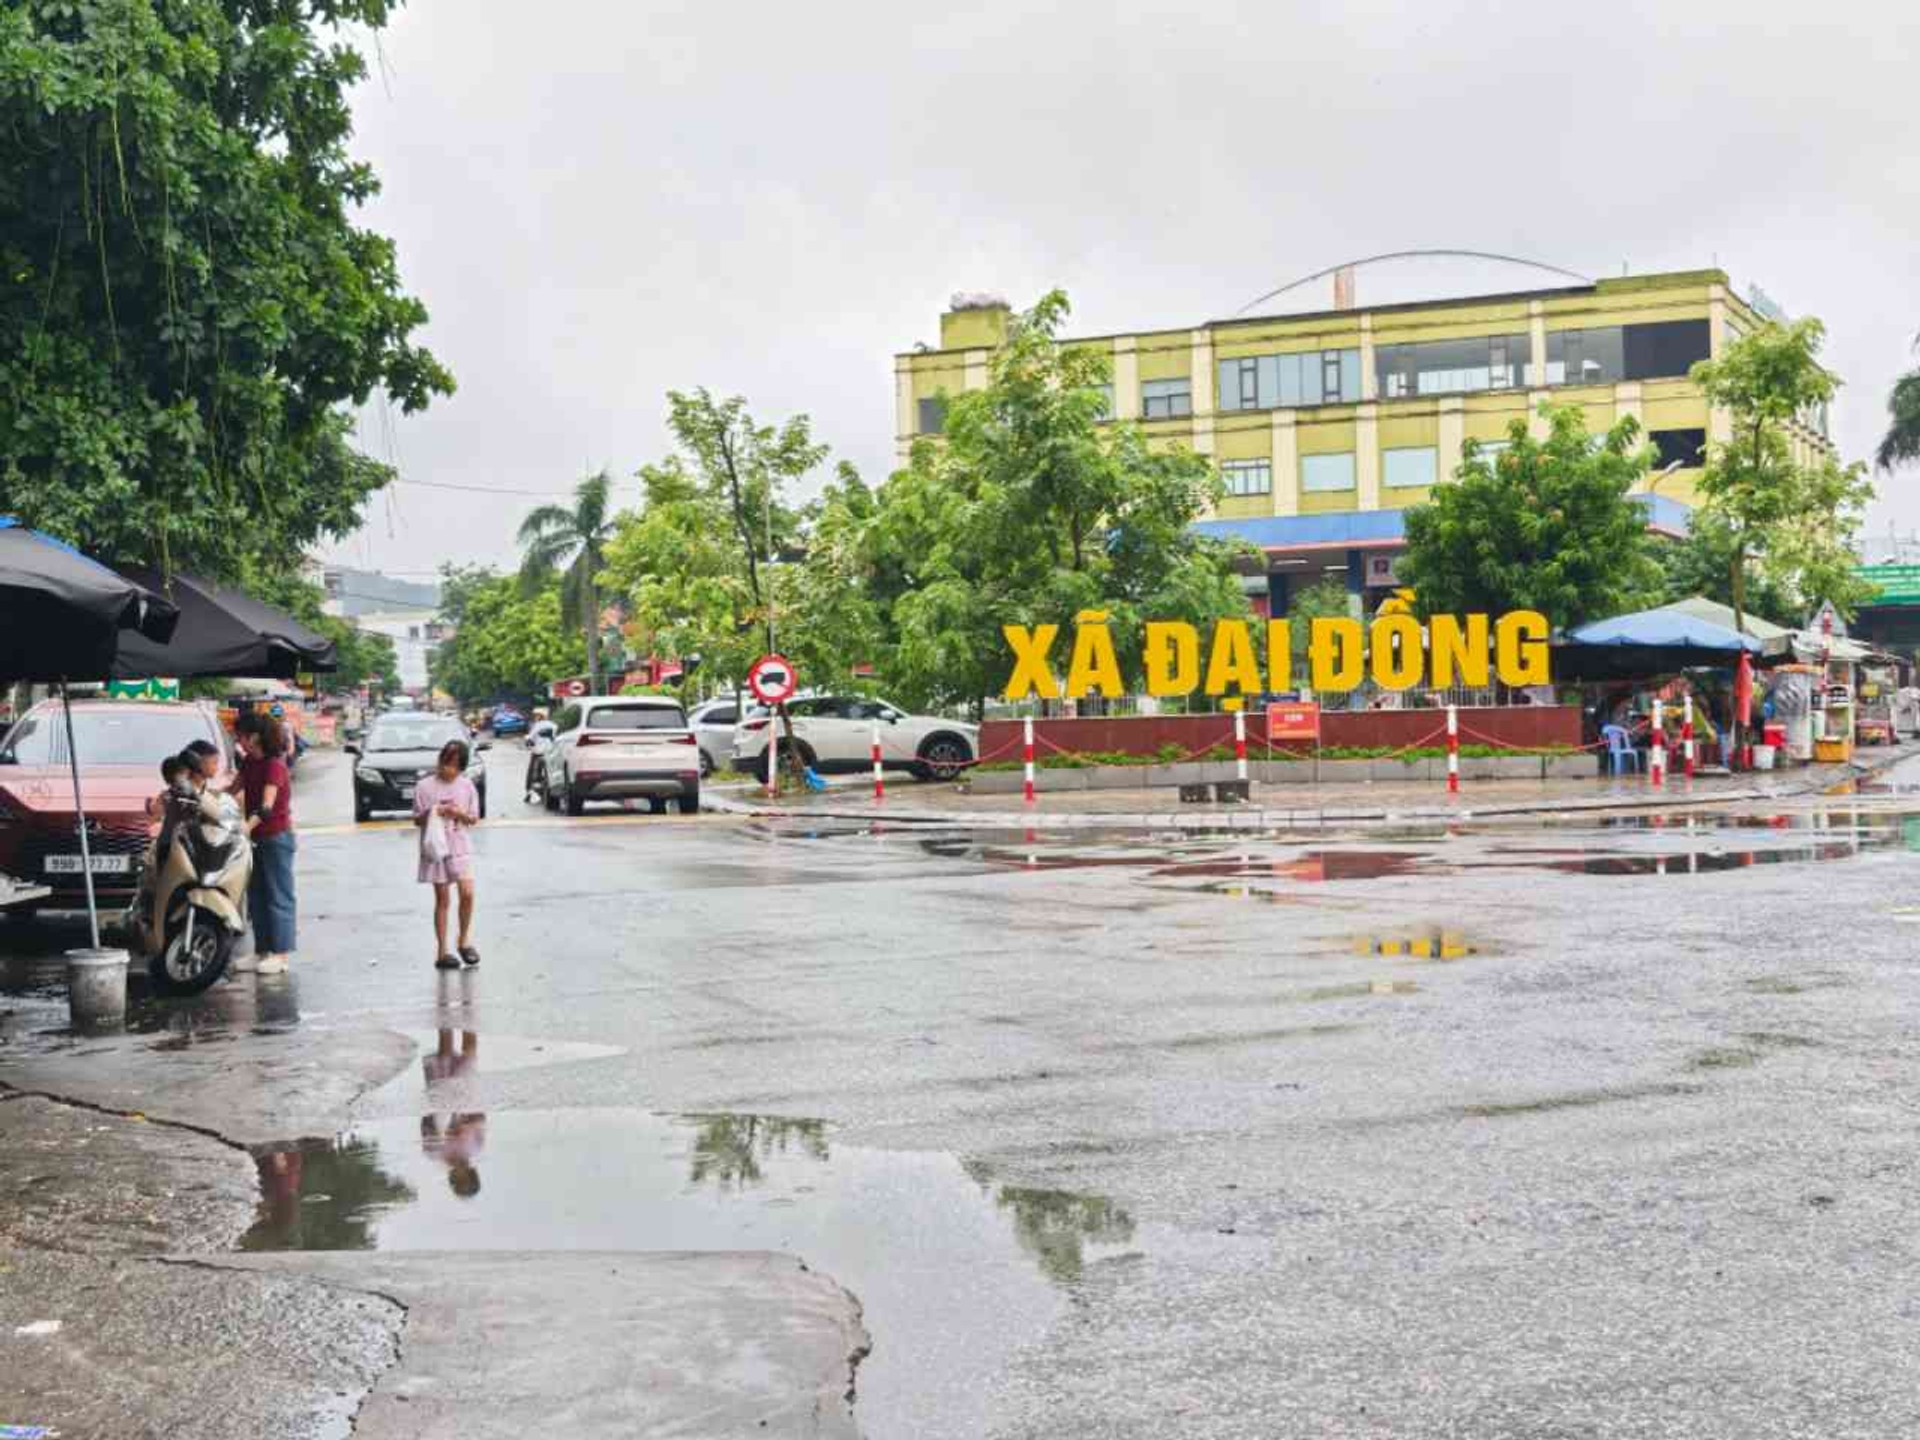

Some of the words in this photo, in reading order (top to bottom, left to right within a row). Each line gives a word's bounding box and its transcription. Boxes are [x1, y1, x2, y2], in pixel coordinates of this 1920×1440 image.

[1004, 609, 1124, 700] XÃ
[1143, 619, 1291, 711] ĐẠI
[1308, 588, 1550, 692] ĐỒNG
